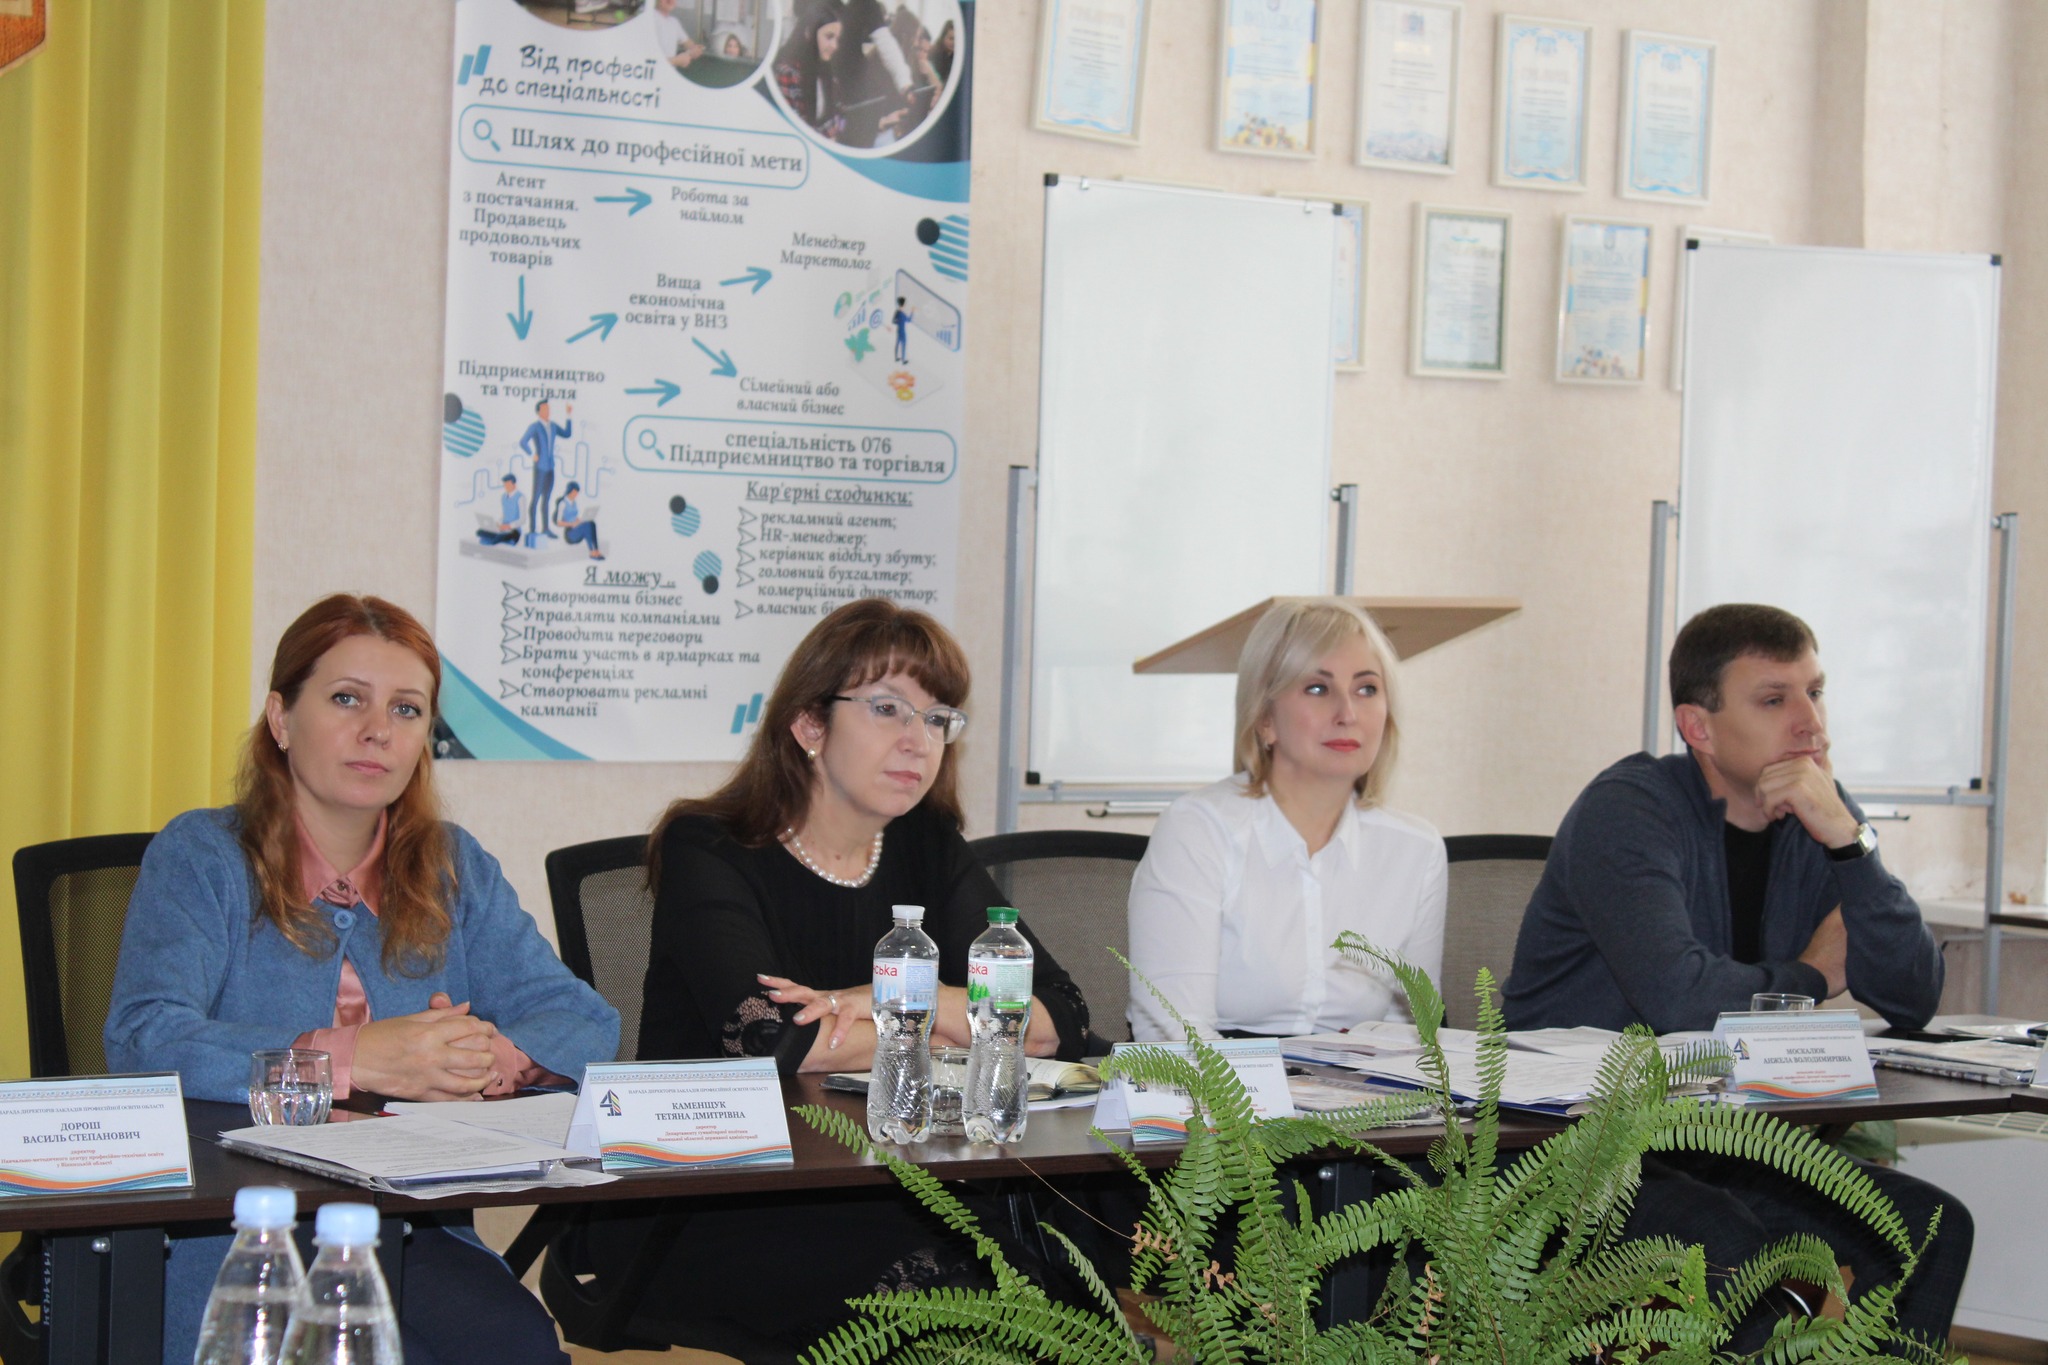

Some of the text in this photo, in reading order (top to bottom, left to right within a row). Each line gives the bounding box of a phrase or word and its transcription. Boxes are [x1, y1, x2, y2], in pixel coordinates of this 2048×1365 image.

[520, 45, 657, 82] Від професії
[479, 77, 660, 109] до спеціальності
[511, 127, 802, 172] Шлях до професійної мети
[496, 171, 547, 189] Агент
[463, 191, 579, 211] з постачання.
[671, 186, 749, 206] Робота за
[474, 207, 567, 232] Продавець
[680, 208, 744, 225] наймом
[459, 229, 581, 250] продовольчих
[792, 232, 866, 255] Менеджер
[490, 250, 553, 269] товарів
[780, 250, 872, 270] Маркетолог
[656, 273, 701, 292] Вища
[629, 292, 725, 310] економічна
[625, 310, 728, 331] освіта у ВНЗ
[458, 360, 606, 383] Підприємництво
[480, 383, 577, 401] та торгівля
[739, 377, 840, 397] Сімейний або
[737, 398, 845, 416] власний бізнес
[725, 432, 892, 455] спеціальність 076
[669, 444, 945, 477] Підприємництво та торгівля
[746, 481, 914, 506] Кар'єрні сходинки:
[760, 512, 897, 530] рекламний агент;
[759, 527, 867, 548] HR-менеджер;
[759, 549, 937, 569] керівник відділу збуту;
[583, 565, 598, 584] Я
[758, 565, 912, 586] головний бухгалтер;
[524, 587, 682, 607] Створювати бізнес
[758, 585, 855, 599] комерційний
[524, 606, 720, 626] Управляти компаніями
[756, 602, 817, 615] власник
[523, 626, 703, 647] Проводити переговори
[522, 645, 761, 667] Брати участь в ярмарках та
[522, 663, 634, 682] конференціях
[520, 682, 708, 703] Створювати рекламні
[520, 701, 598, 717] кампанії
[1794, 1056, 1852, 1064] ВОЛОДИМИРІВНА
[672, 1101, 726, 1110] КАМЕНЩУК
[655, 1111, 746, 1121] ТЕТЯНА ДМИТРІВНА
[60, 1121, 101, 1132] ДОРОШ
[22, 1131, 141, 1144] ВАСИЛЬ СТЕПАНОВИЧ
